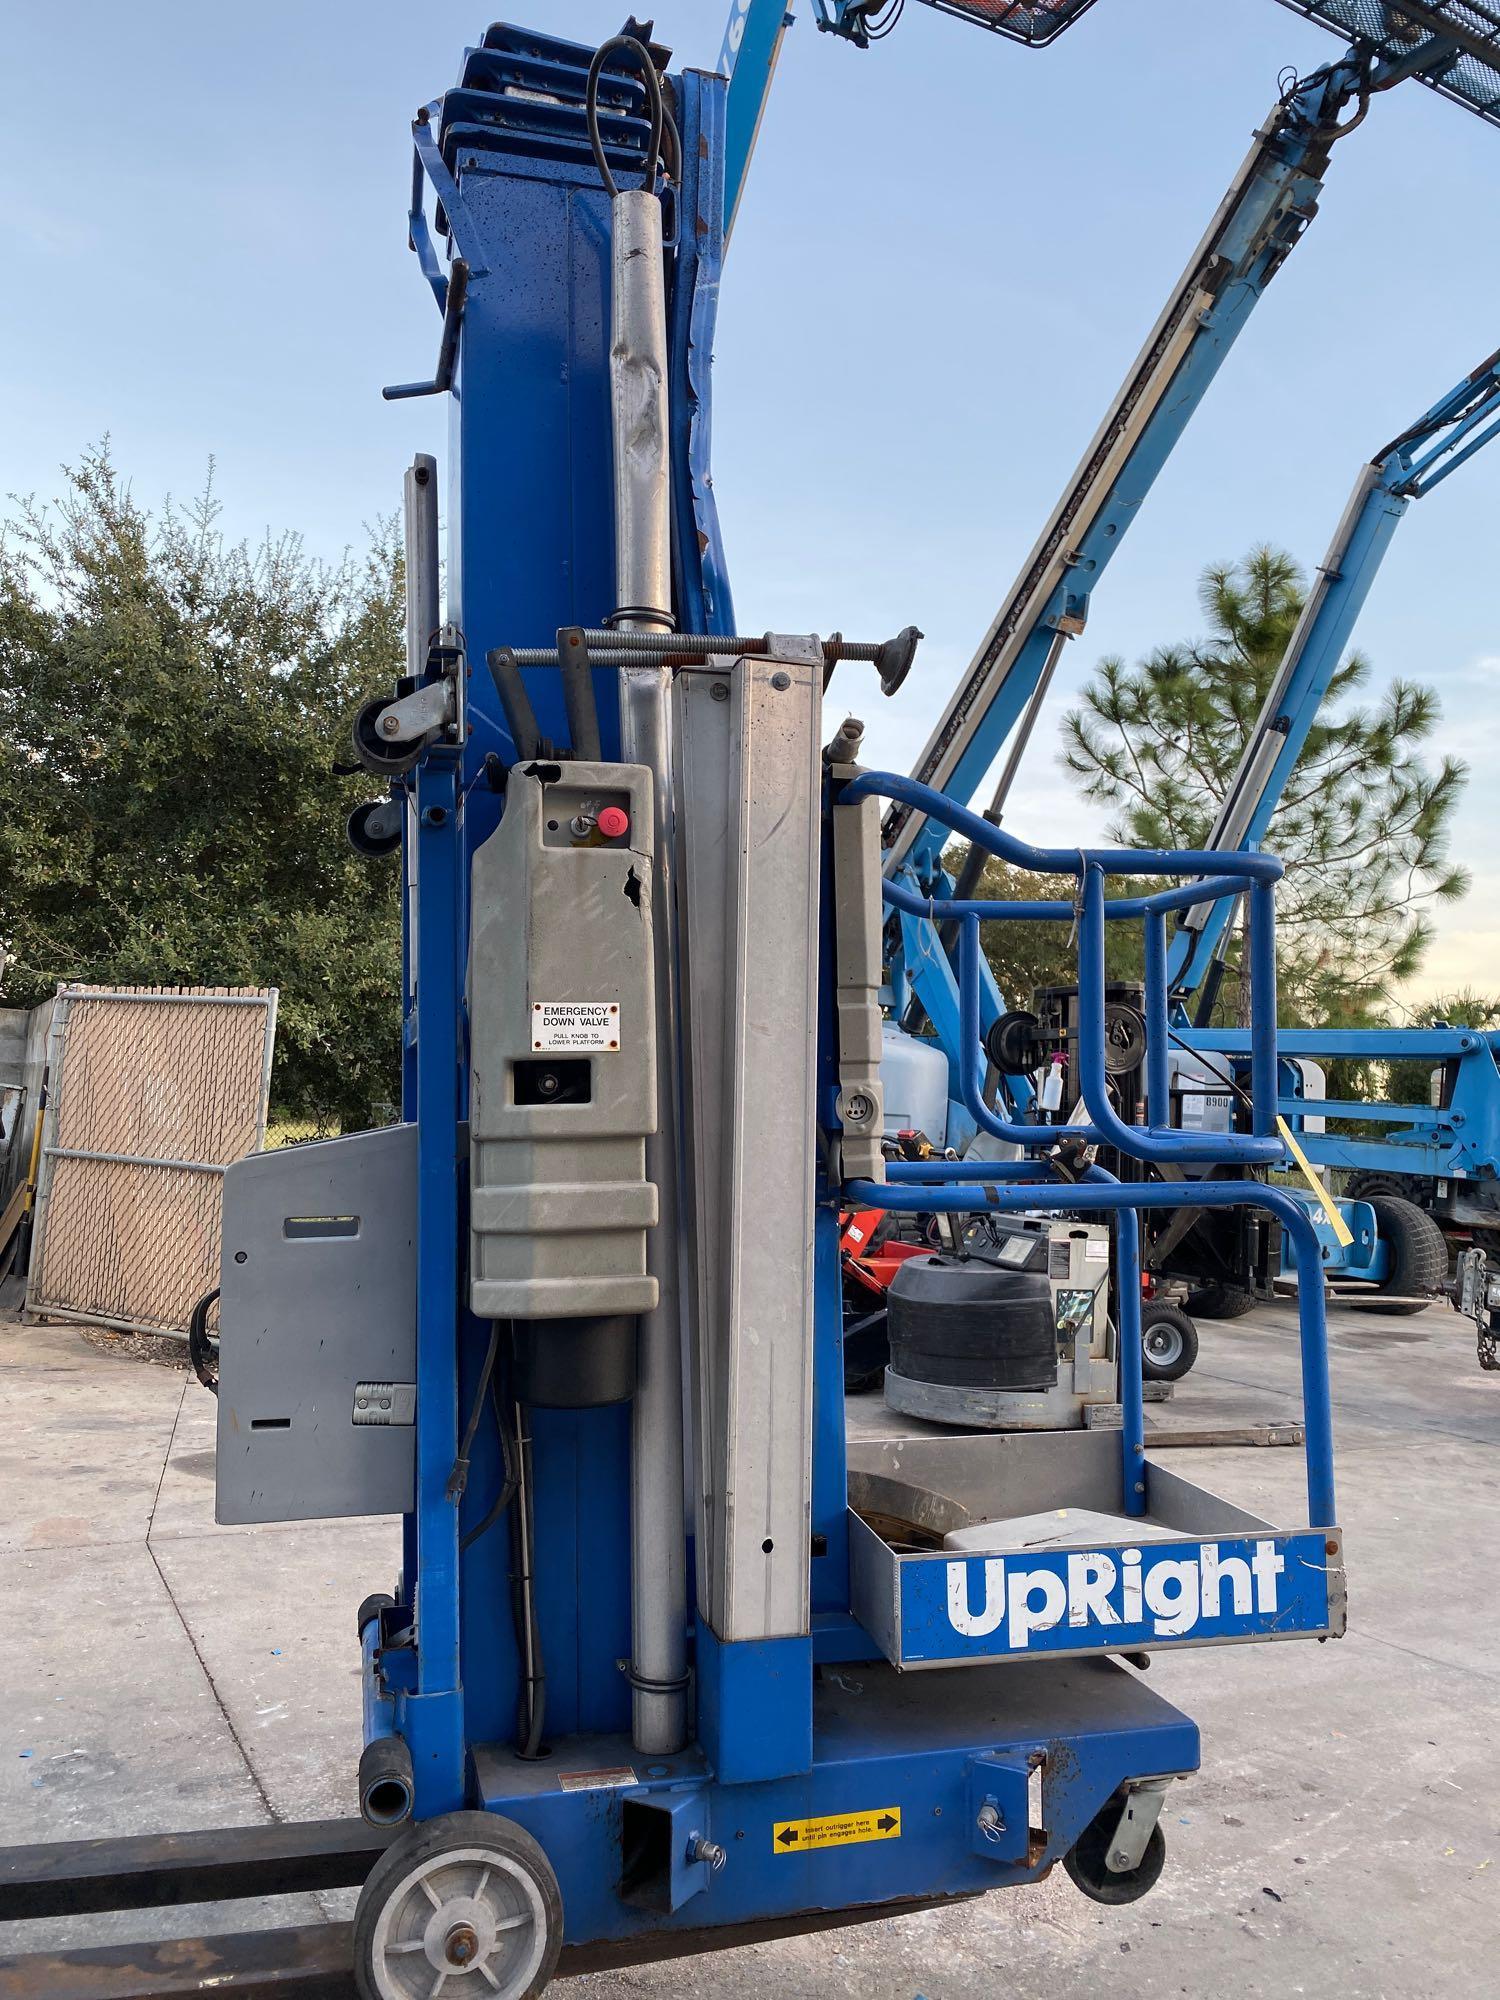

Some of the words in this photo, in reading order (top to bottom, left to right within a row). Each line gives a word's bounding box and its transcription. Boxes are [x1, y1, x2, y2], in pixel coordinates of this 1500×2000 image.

[544, 1006, 608, 1016] EMERGENCY
[543, 1017, 575, 1026] DOWN
[580, 1017, 610, 1026] VALVE
[946, 1540, 1285, 1648] UpRight
